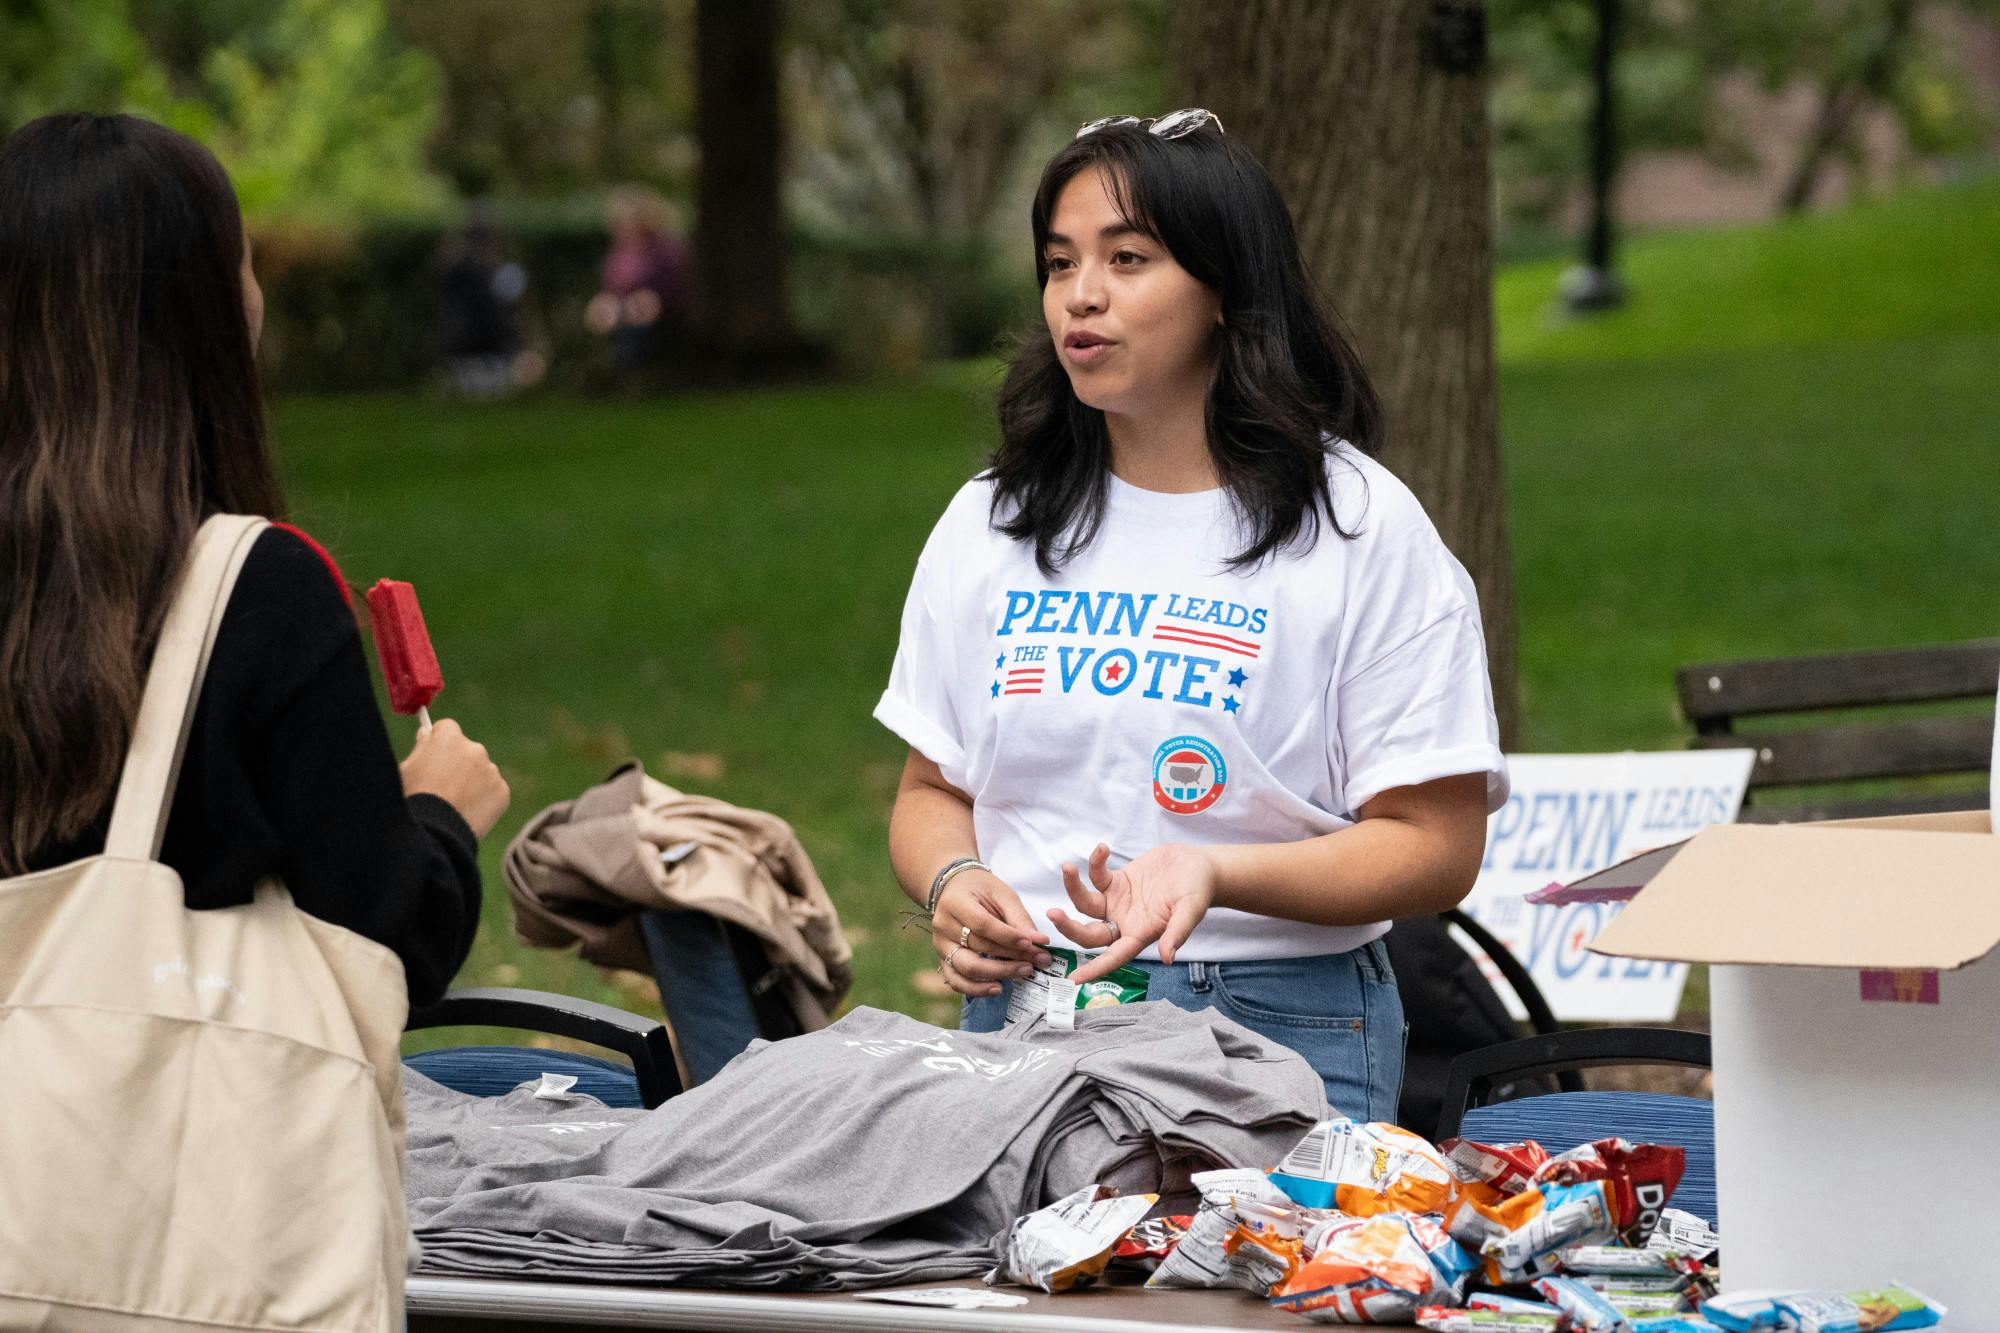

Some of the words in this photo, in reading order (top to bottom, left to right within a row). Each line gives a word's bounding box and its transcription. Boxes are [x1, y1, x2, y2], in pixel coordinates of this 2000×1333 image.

[997, 590, 1158, 637] PENN
[1163, 593, 1268, 634] LEADS
[1013, 645, 1048, 663] THE
[1057, 646, 1220, 707] VOTE
[1480, 790, 1637, 869] PENN
[1522, 900, 1653, 979] VO
